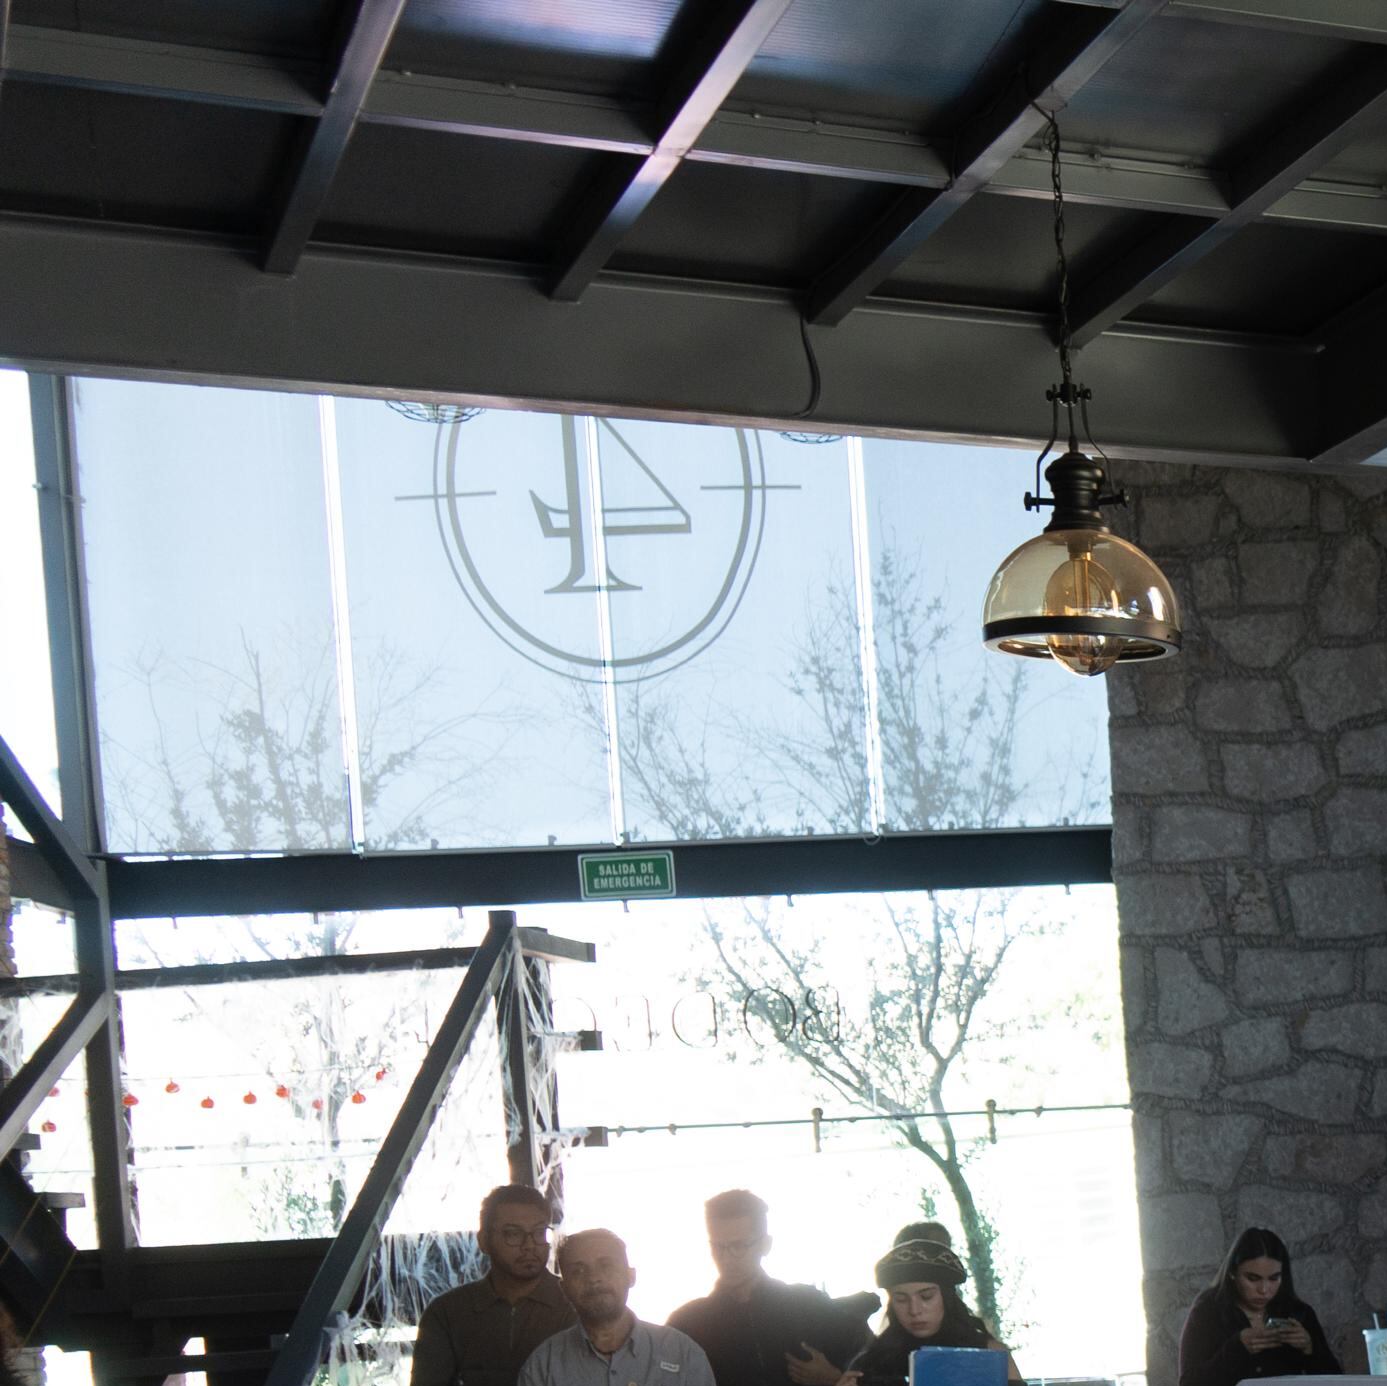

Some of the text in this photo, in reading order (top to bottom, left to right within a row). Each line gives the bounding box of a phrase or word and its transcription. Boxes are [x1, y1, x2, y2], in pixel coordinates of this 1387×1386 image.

[598, 861, 654, 876] SALIDA DE
[593, 875, 661, 889] EMERGENCIA
